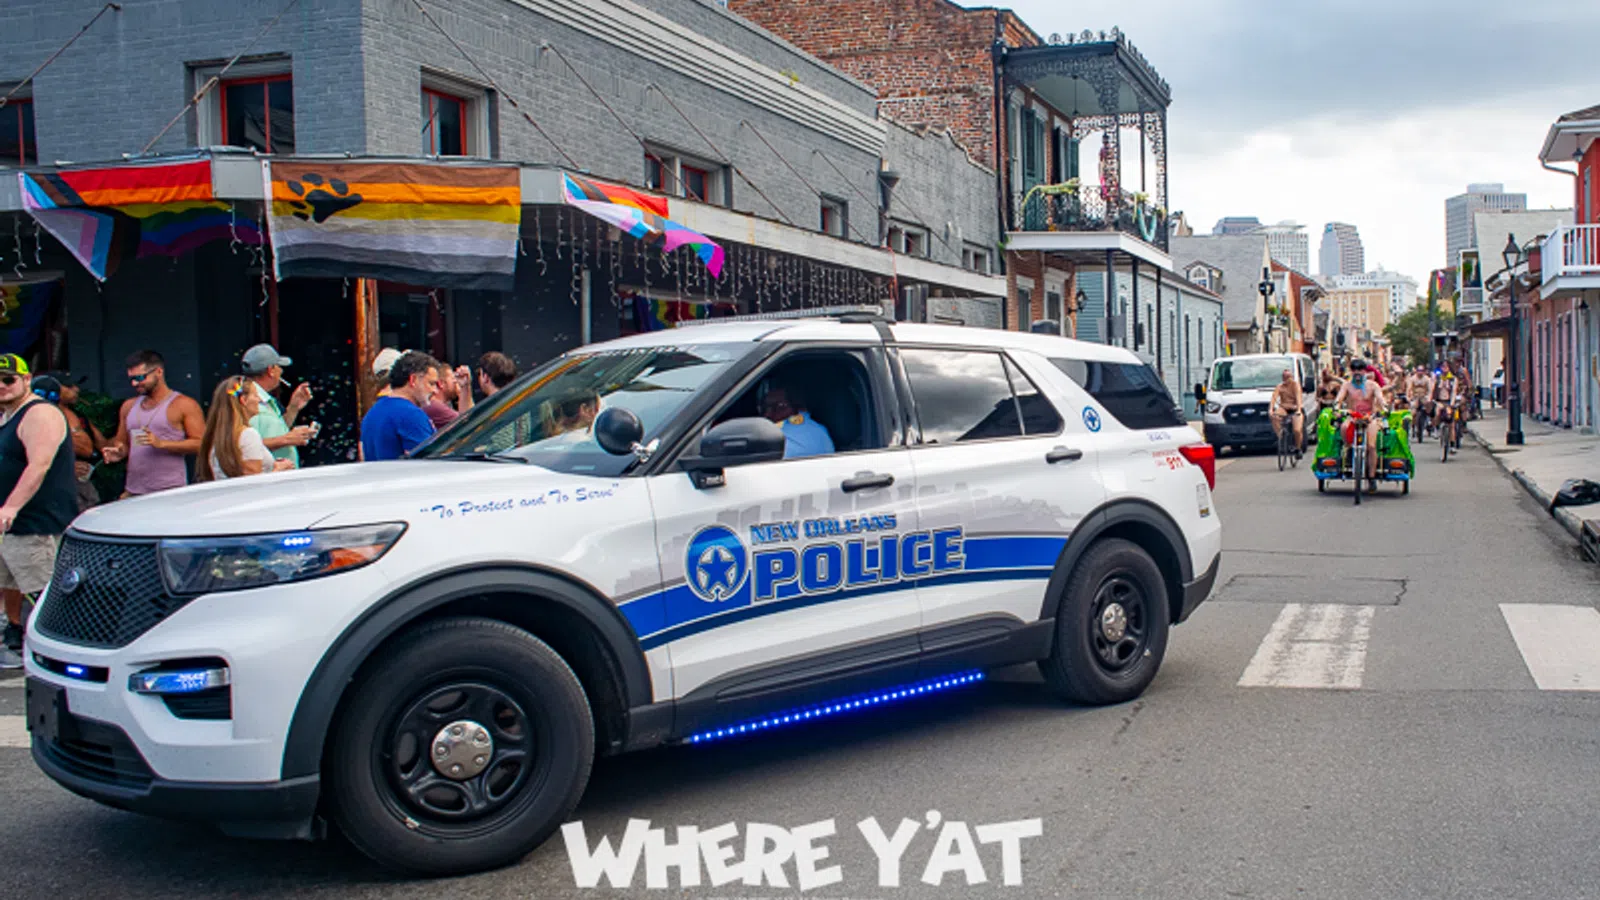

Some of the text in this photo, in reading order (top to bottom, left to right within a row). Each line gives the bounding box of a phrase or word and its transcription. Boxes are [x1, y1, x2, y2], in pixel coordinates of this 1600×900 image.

[459, 499, 514, 516] Protect
[520, 494, 547, 508] and
[549, 489, 569, 503] To
[750, 514, 897, 545] NEW ORLEANS
[753, 526, 964, 601] POLICE
